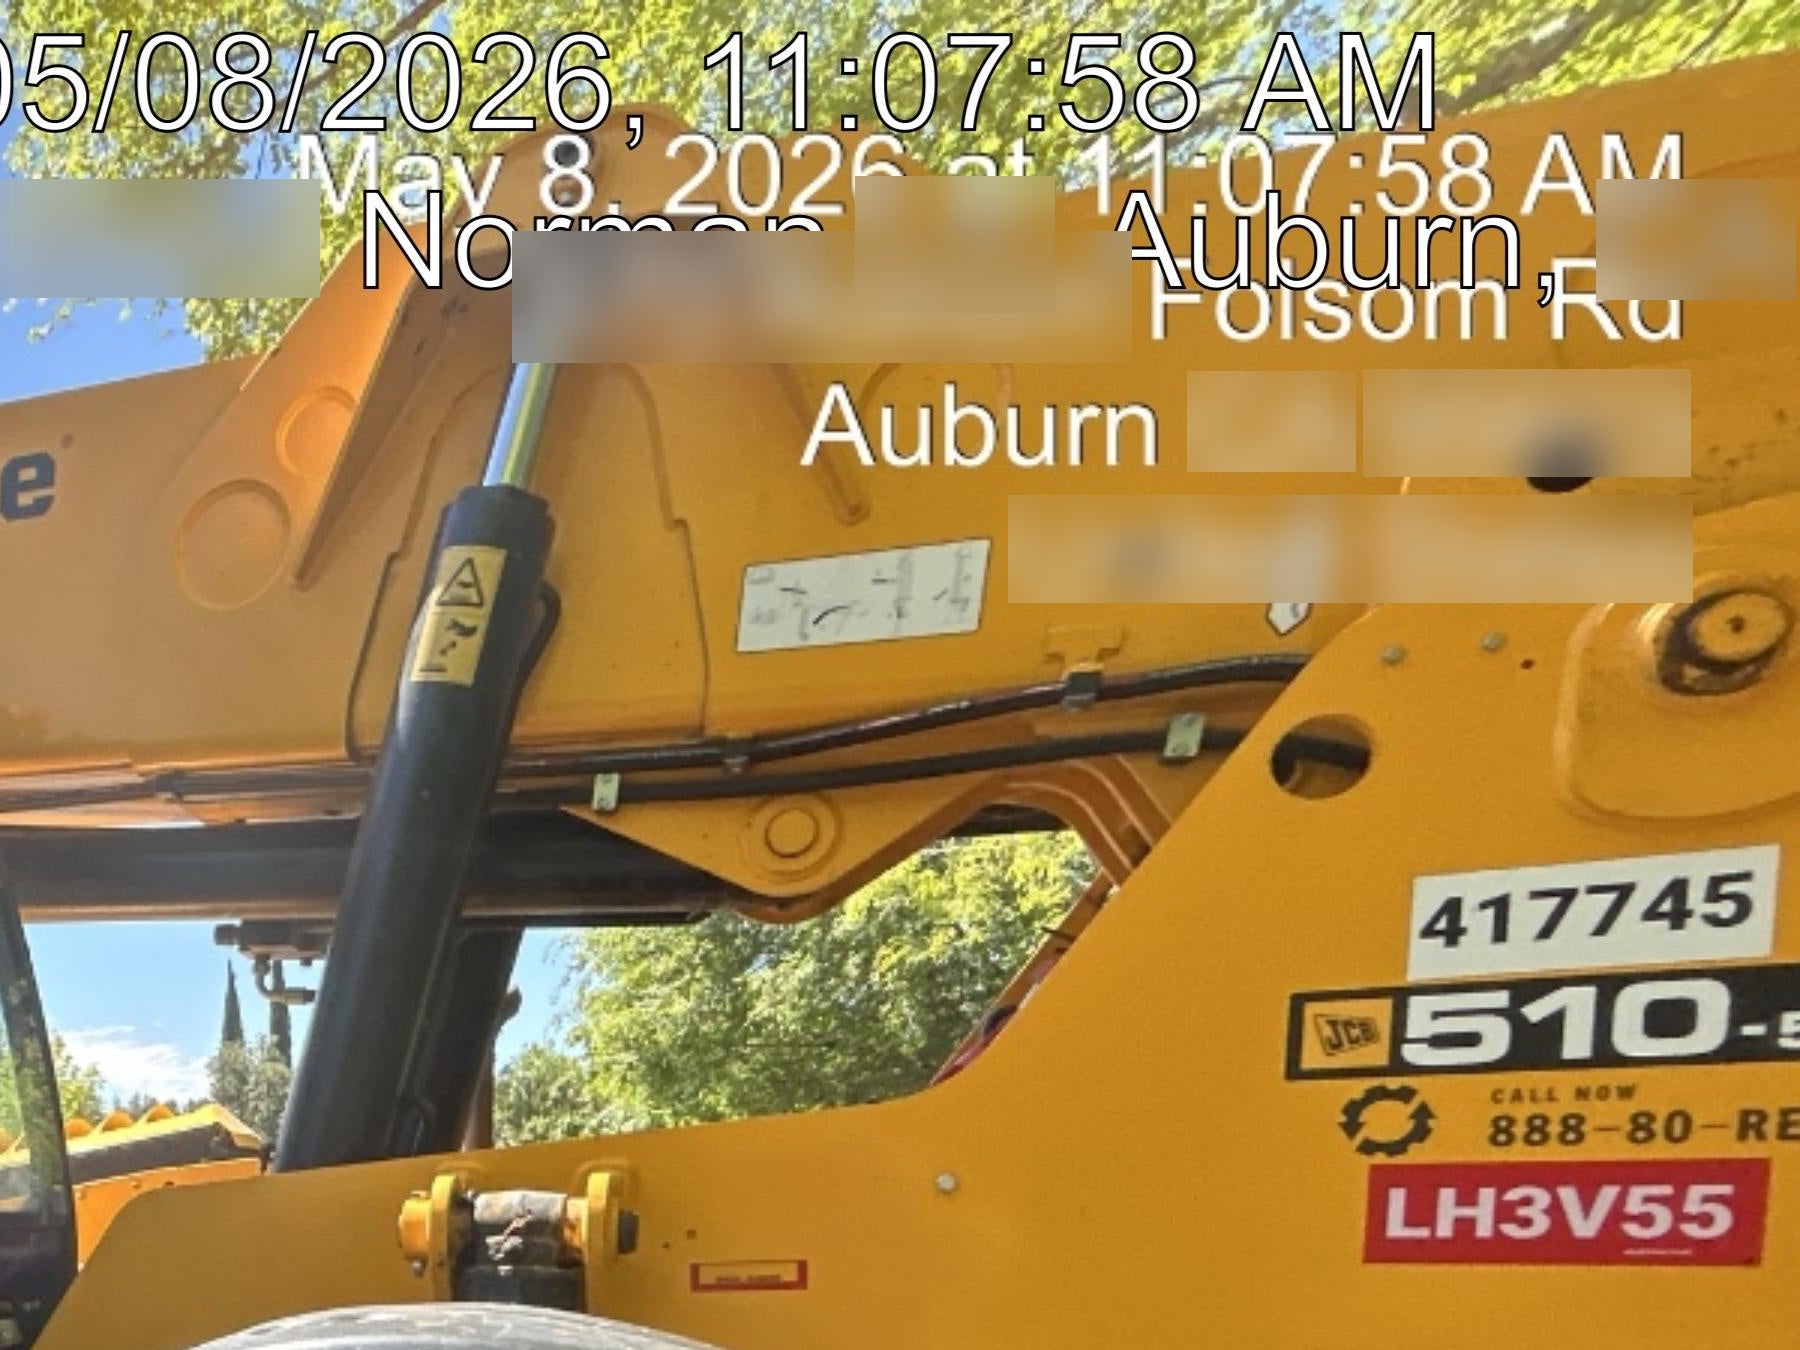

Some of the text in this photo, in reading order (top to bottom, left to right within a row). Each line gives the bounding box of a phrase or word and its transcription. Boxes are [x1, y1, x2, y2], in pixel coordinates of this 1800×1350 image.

[1419, 870, 1755, 949] 417745
[1318, 1014, 1381, 1054] JCB
[1490, 1083, 1639, 1106] CALL NOW
[1385, 1183, 1736, 1241] LH3V55
